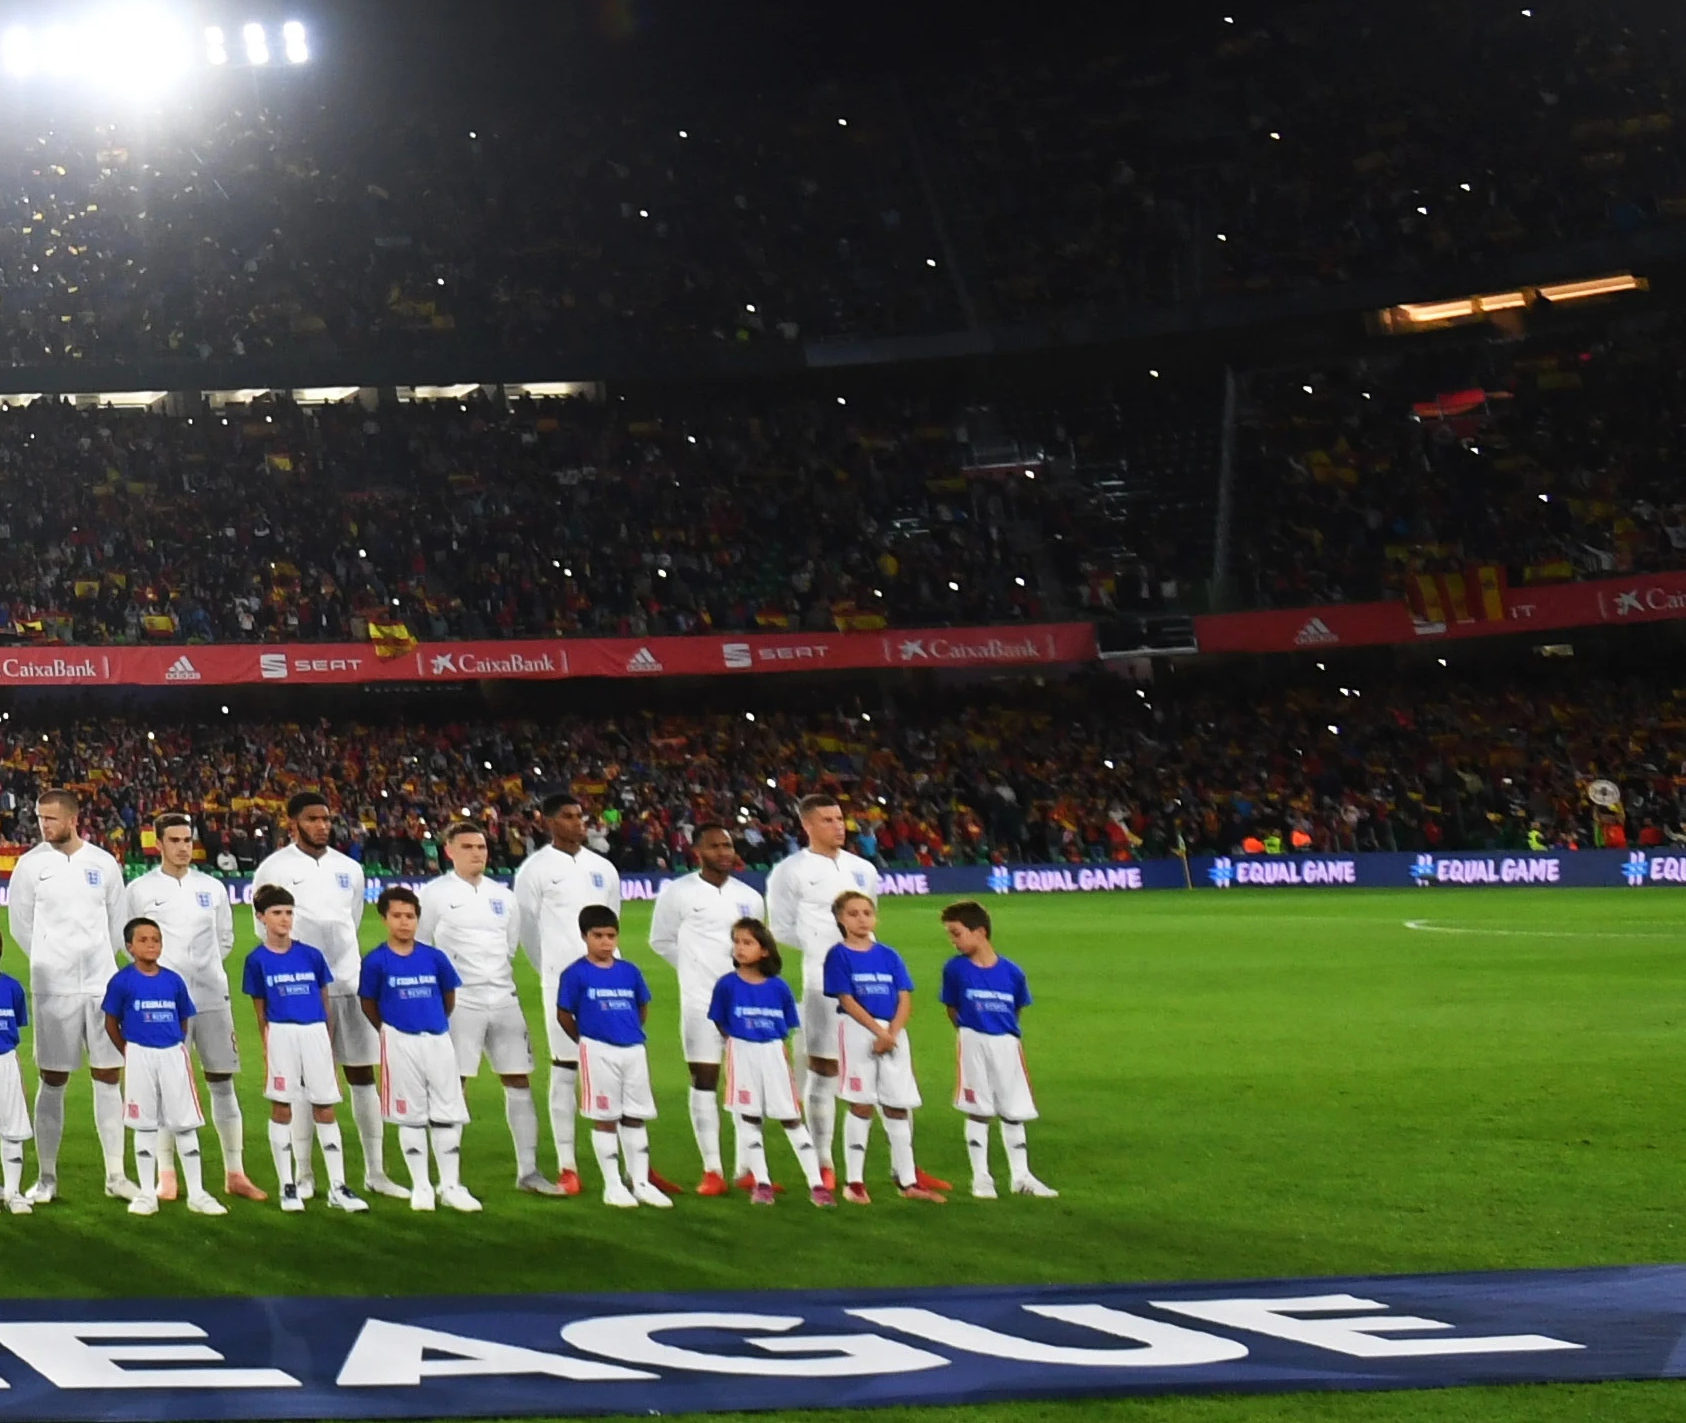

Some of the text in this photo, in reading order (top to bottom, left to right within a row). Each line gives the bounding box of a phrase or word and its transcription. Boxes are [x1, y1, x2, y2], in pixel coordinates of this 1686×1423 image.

[758, 646, 828, 660] SEAT
[929, 636, 1039, 660] CaixaBank
[2, 659, 96, 679] CaixaBank
[165, 668, 201, 681] adidas
[295, 659, 361, 672] SEAT
[459, 655, 555, 675] CaixaBank
[627, 660, 663, 672] adidas
[1208, 856, 1355, 888] #EQUAL GAME
[1410, 854, 1560, 886] #EQUAL GAME
[1621, 852, 1686, 885] #EQU
[988, 866, 1142, 894] #EQUAL GAME
